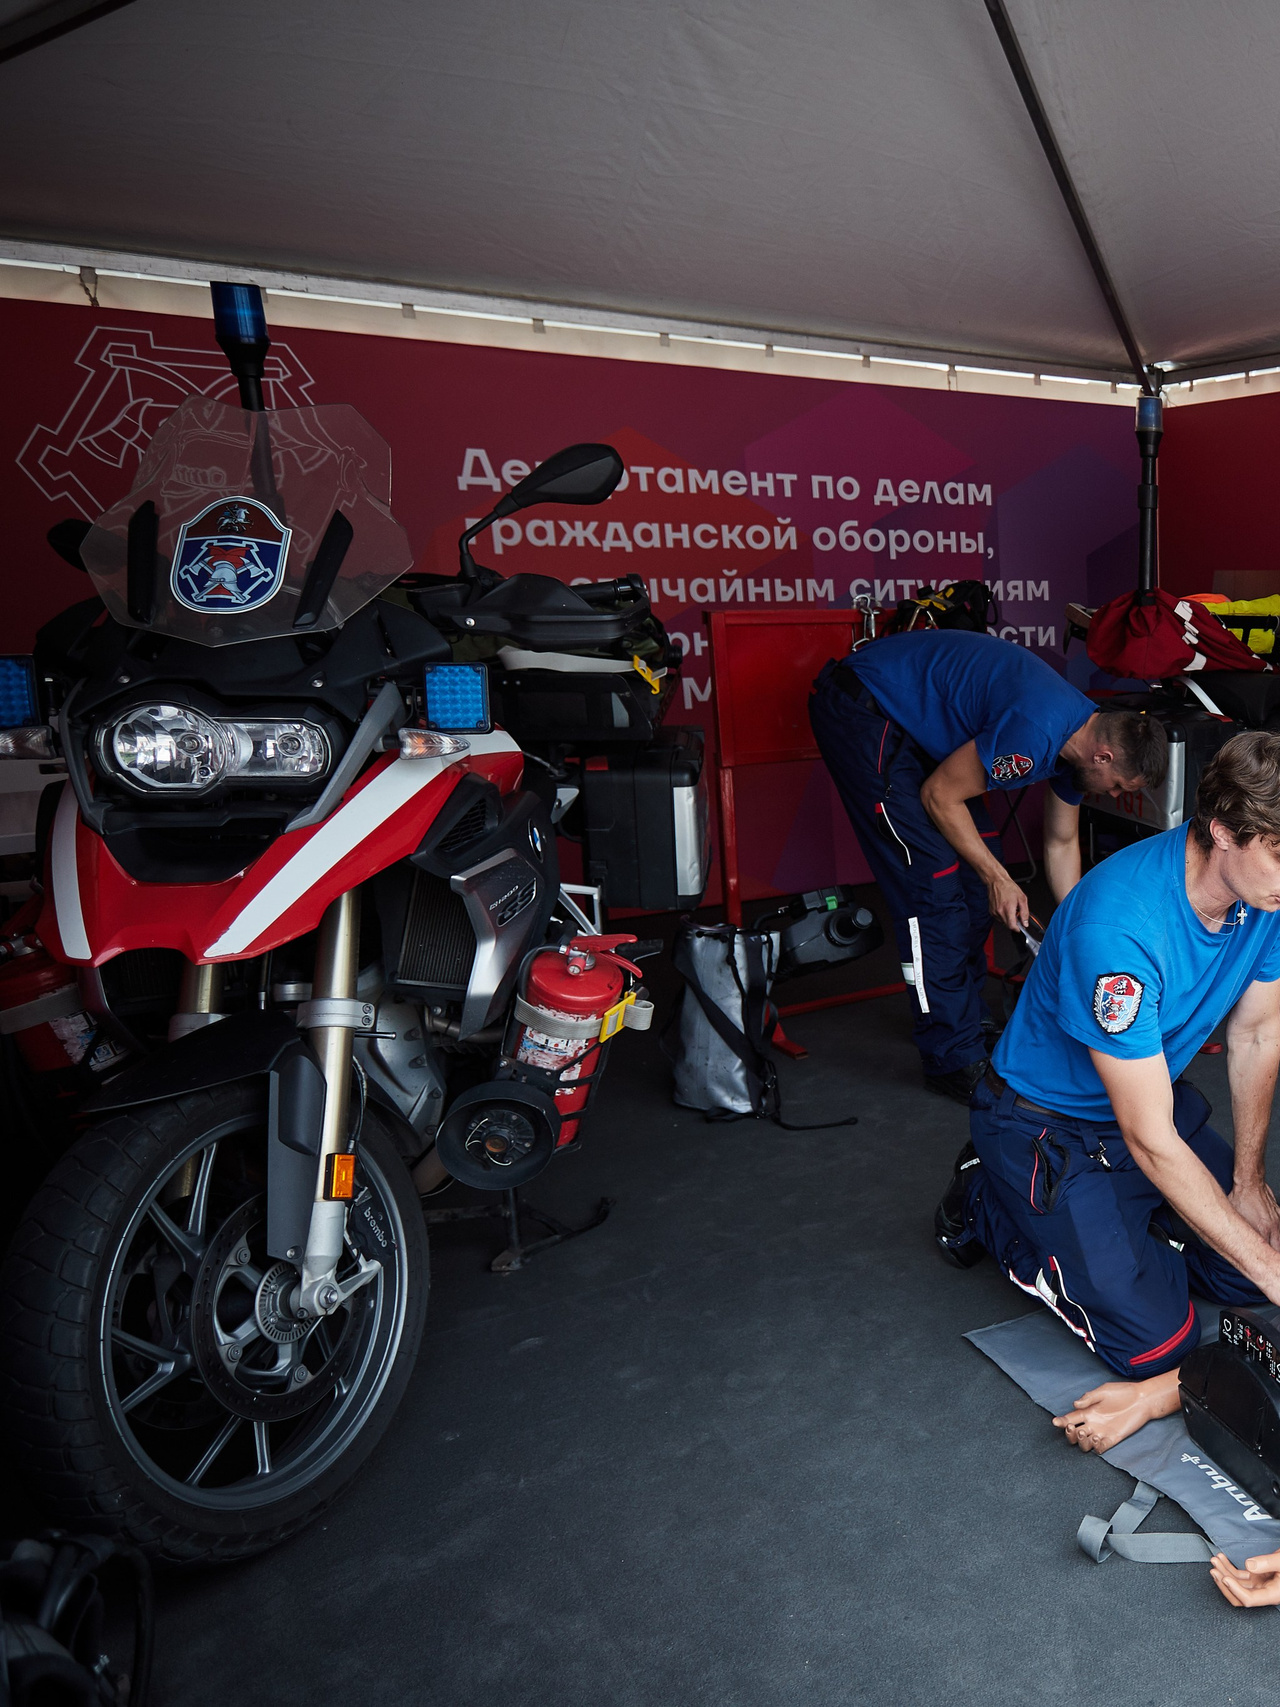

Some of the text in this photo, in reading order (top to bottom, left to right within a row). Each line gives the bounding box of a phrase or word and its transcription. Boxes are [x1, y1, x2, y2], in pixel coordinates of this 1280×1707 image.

[457, 448, 992, 506] Детамент по делам
[465, 516, 994, 560] гражданской обороны,
[364, 1206, 388, 1248] brembo
[1198, 1464, 1272, 1521] Ambu
